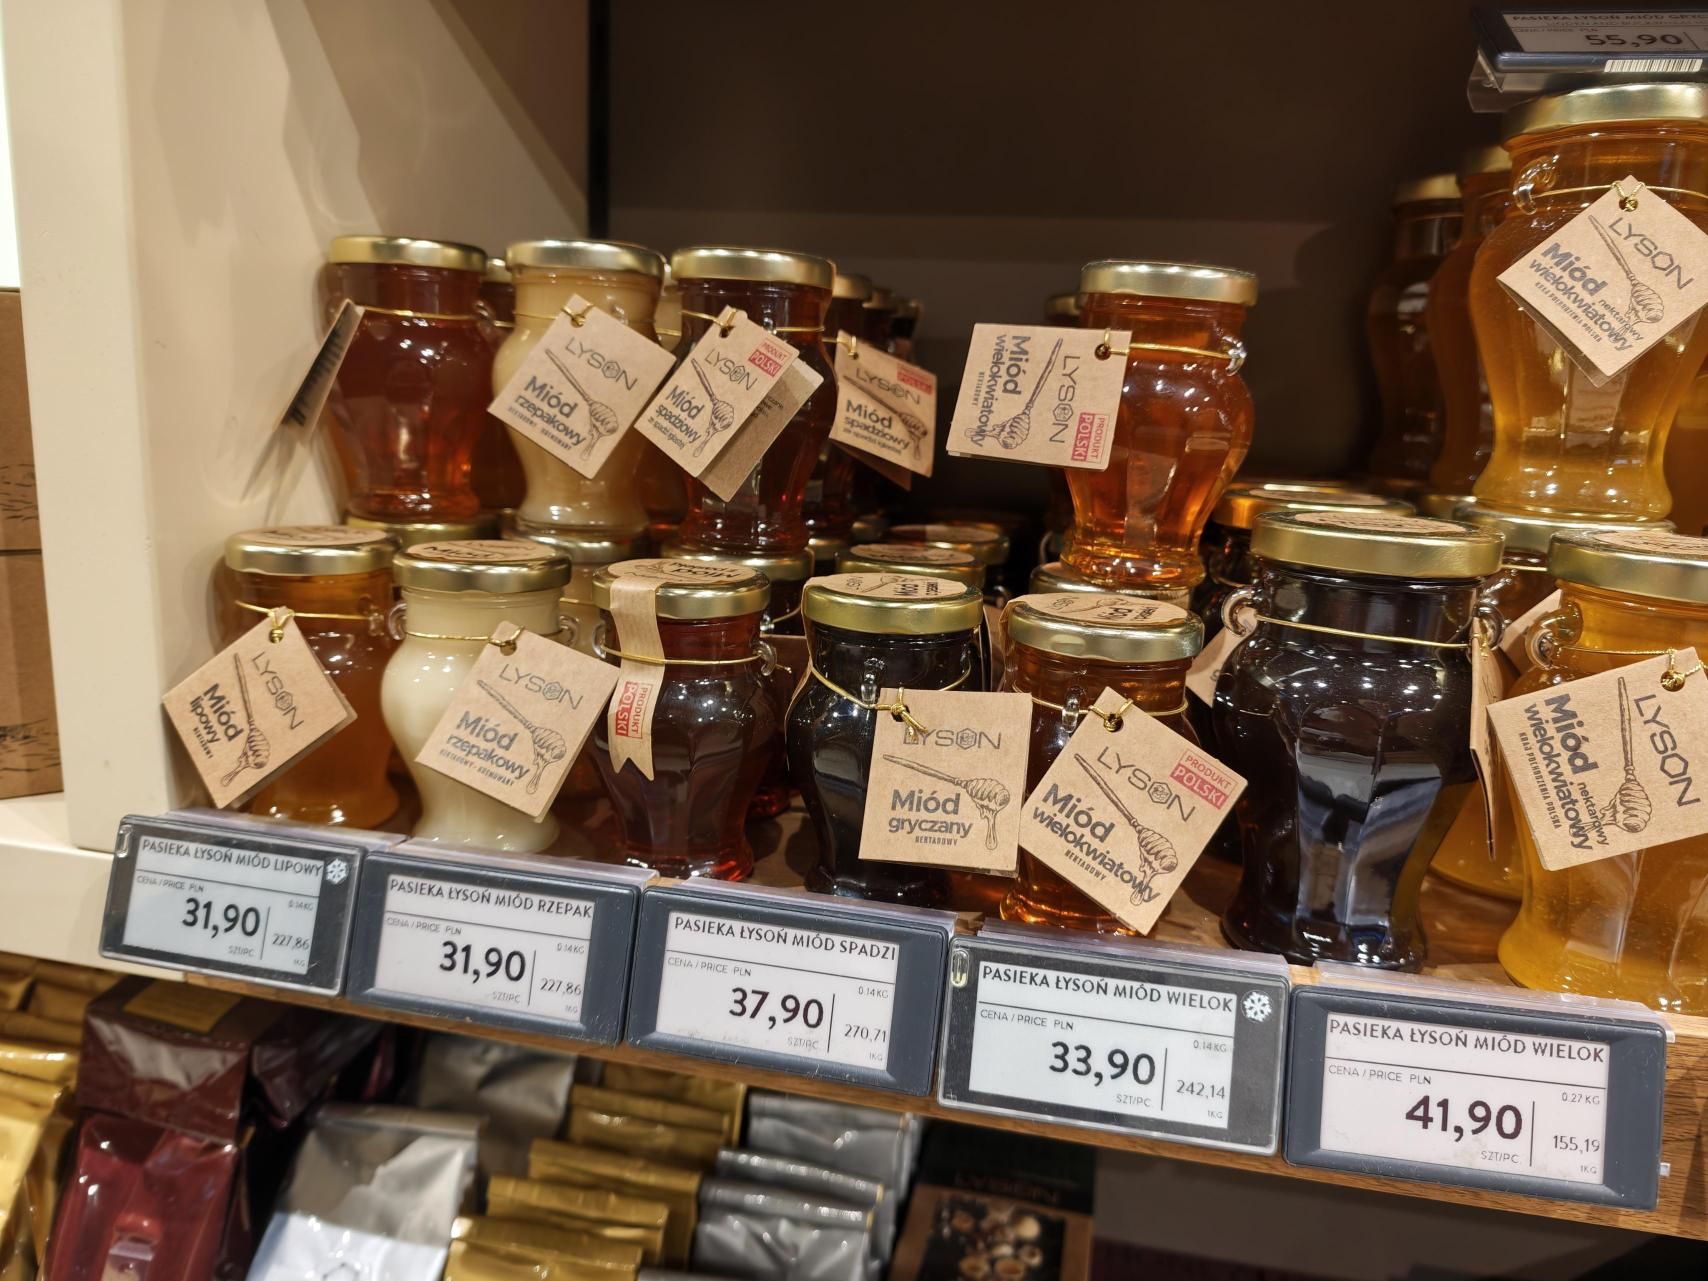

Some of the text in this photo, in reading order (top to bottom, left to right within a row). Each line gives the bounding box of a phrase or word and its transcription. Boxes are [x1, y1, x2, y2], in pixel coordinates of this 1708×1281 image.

[1585, 34, 1683, 47] 55,90
[1541, 242, 1609, 297] Miód
[1608, 217, 1694, 290] LYSON
[1528, 259, 1634, 352] wielokwiatowy
[1598, 299, 1645, 342] nektarowy
[565, 336, 638, 391] LYSON
[704, 348, 758, 391] LYSON
[752, 353, 780, 375] POLSKI
[1002, 335, 1031, 395] Miód
[524, 375, 579, 419] Miód
[667, 385, 705, 421] Miód
[856, 367, 920, 405] LYSON
[970, 334, 1008, 447] wielokwiatowy
[1048, 355, 1080, 443] LYSON
[514, 395, 587, 447] rzepakowy
[655, 403, 701, 444] spadziowy
[844, 416, 910, 450] spadziowy
[846, 399, 893, 430] Miód
[1074, 414, 1094, 460] POLSKI
[1090, 416, 1106, 460] PRODUKT
[252, 651, 304, 730] LYSON
[498, 664, 584, 710] LYSON
[616, 683, 638, 735] POLSKI
[190, 695, 221, 744] lipowy
[203, 683, 245, 742] Miód
[456, 710, 519, 752] Miód
[631, 686, 649, 734] PRODUKT
[1544, 693, 1600, 775] Miód
[1634, 694, 1702, 807] LYSON
[447, 734, 530, 780] rzepakowy
[1184, 754, 1232, 790] PRODUKT
[1523, 702, 1594, 850] wielokwiatowy
[890, 788, 961, 816] Miód
[1096, 746, 1196, 822] LYSON
[1173, 766, 1227, 807] POLSKI
[1518, 732, 1531, 751] KRAJ
[1546, 801, 1562, 830] POLSKA
[888, 817, 973, 839] gryczany
[1042, 783, 1116, 844] Miód
[1577, 782, 1610, 846] nektarowy
[142, 839, 324, 876] PASIEKA ŁYSOŃ MIÓD LIPOWY
[1032, 806, 1161, 903] wielokwiatowy
[1064, 849, 1107, 881] NEKTAROWY
[182, 898, 261, 938] 31,90
[390, 878, 593, 918] PASIEKA ŁYSOŃ MIÓD RZEPAK
[272, 933, 310, 950] 227,86
[386, 916, 410, 928] CENA
[416, 920, 441, 933] PRICE
[445, 926, 462, 936] PLN
[674, 916, 896, 961] PASIEKA ŁYSOŃ MIÓD SPADZI
[439, 940, 526, 985] 31,90
[668, 956, 693, 969] CENA
[700, 960, 729, 975] PRICE
[733, 965, 752, 977] PLN
[540, 978, 582, 996] 227,86
[729, 986, 824, 1030] 37,90
[982, 965, 1234, 1013] PASIEKA ŁYSOŃ MIÓD WIELOK
[844, 1023, 888, 1044] 270,71
[980, 1008, 1008, 1022] CENA
[1017, 1014, 1048, 1028] PRICE
[1054, 1020, 1074, 1032] PLN
[1330, 1018, 1604, 1063] PASIEKA ŁYSOŃ MIÓD WIELOK
[1049, 1040, 1156, 1088] 33,90
[1328, 1064, 1360, 1078] CENA
[1368, 1069, 1403, 1082] PRICE
[1409, 1074, 1432, 1086] PLN
[1116, 1093, 1152, 1108] SZT/PC
[1176, 1079, 1226, 1100] 242,14
[1207, 1109, 1224, 1120] 1KG
[1405, 1094, 1523, 1143] 41,90
[1480, 1150, 1520, 1165] SZT/PC
[1552, 1134, 1601, 1155] 155,19
[1580, 1165, 1598, 1175] 1KG
